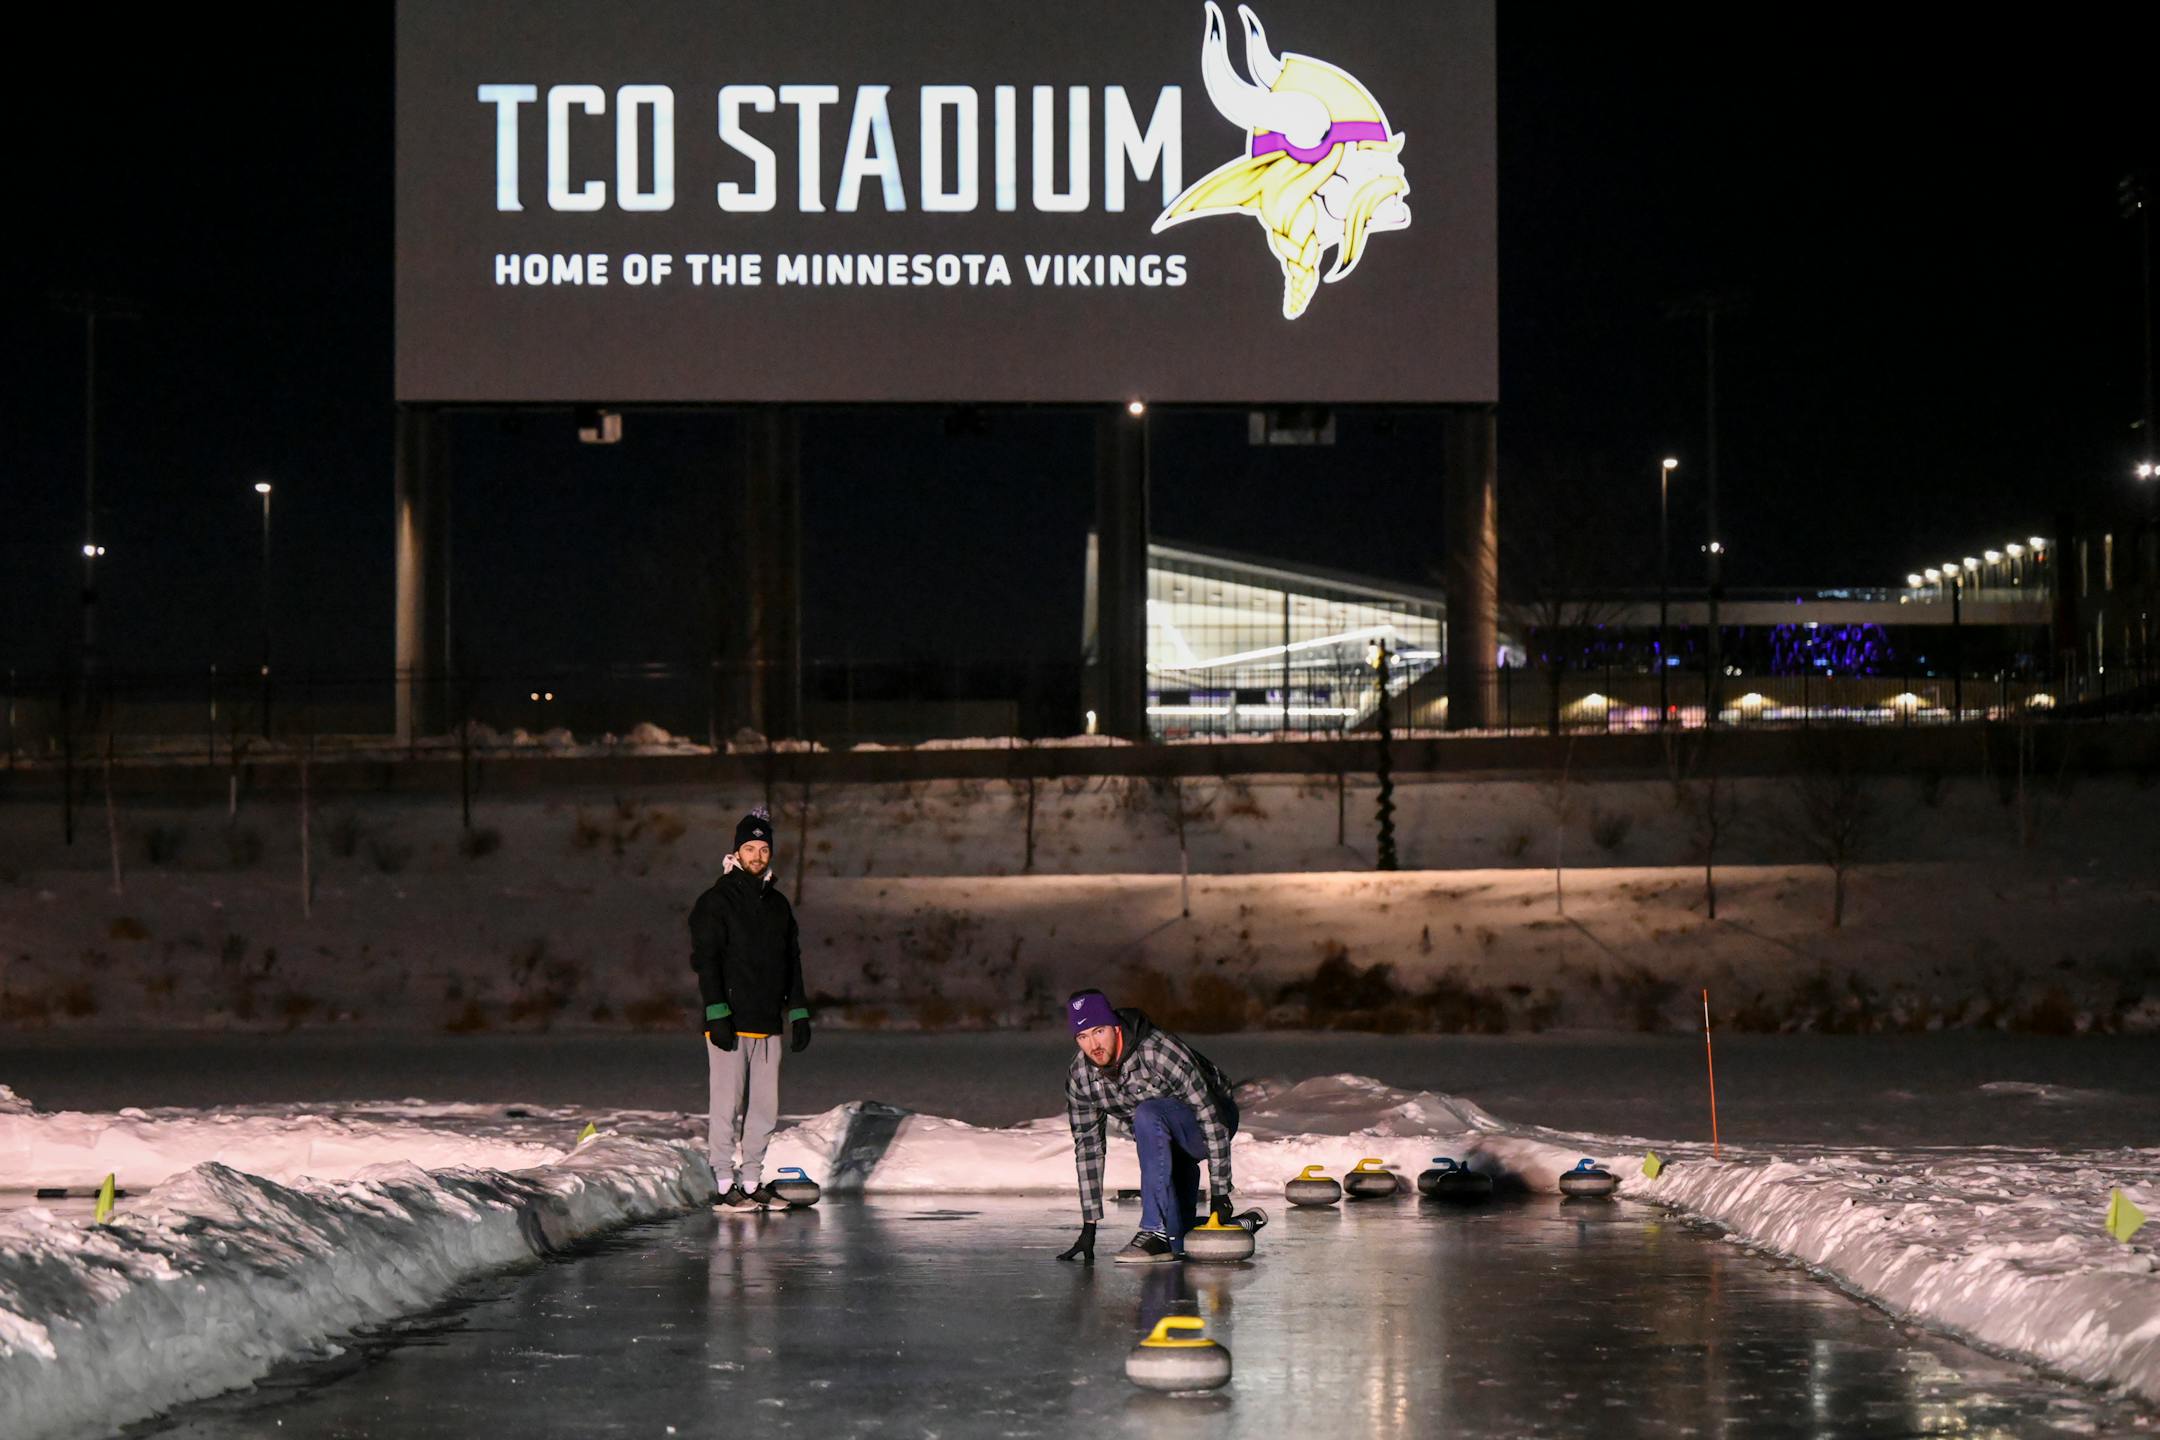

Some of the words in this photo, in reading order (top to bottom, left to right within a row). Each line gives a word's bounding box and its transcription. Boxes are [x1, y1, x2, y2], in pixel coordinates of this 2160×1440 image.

[478, 85, 675, 212] TCO
[718, 85, 1182, 212] STADIUM
[495, 254, 609, 286] HOME
[622, 254, 673, 286] OF
[686, 254, 762, 286] THE
[776, 254, 1012, 286] MINNESOTA
[1025, 254, 1187, 287] VIKINGS
